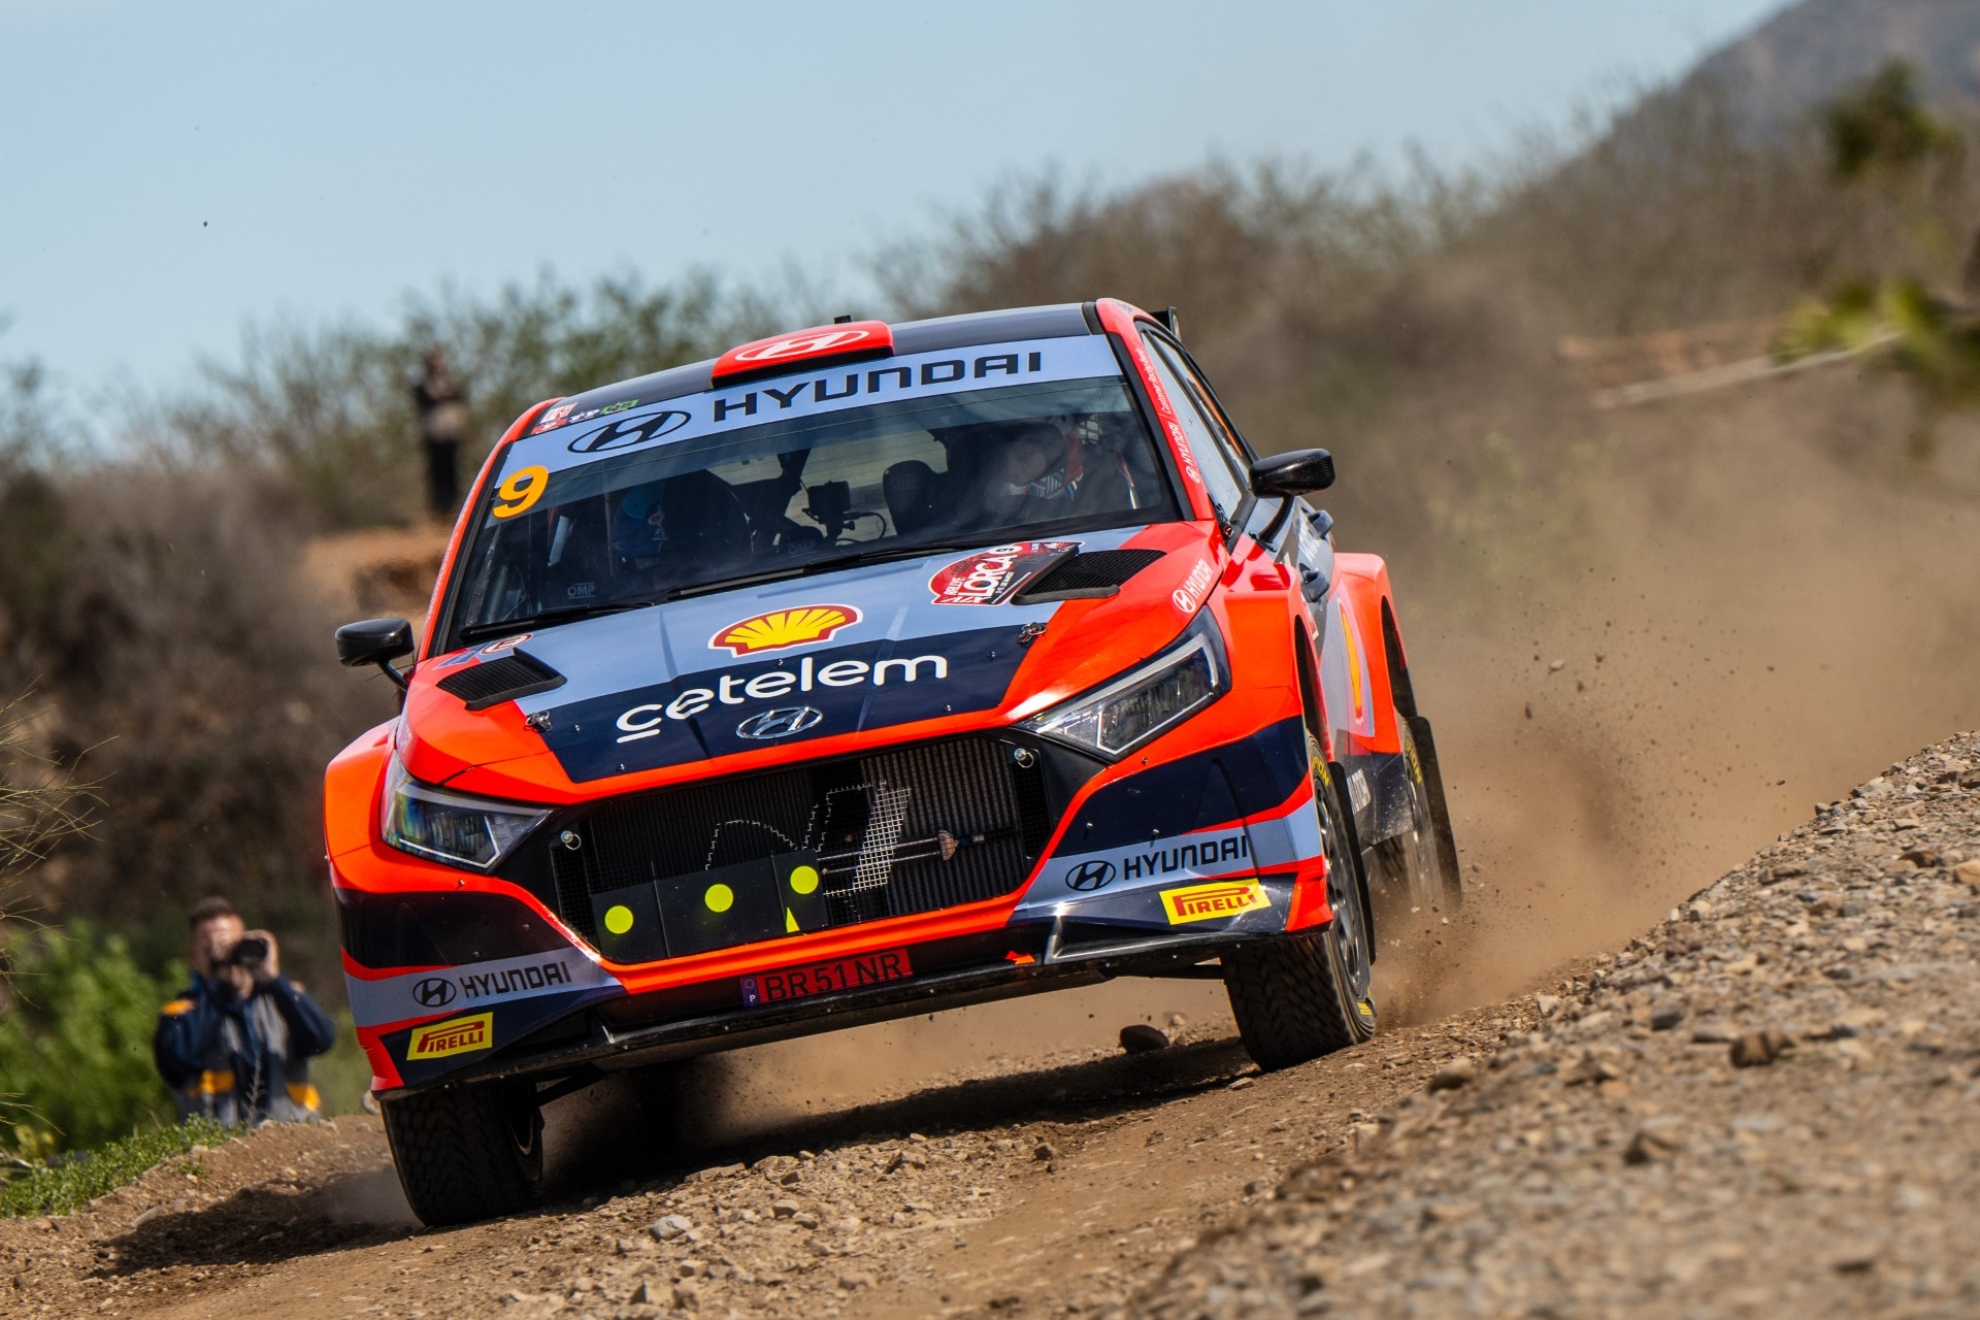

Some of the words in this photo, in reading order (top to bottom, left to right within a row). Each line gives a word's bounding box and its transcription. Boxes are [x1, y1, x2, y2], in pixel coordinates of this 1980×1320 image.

[714, 352, 1041, 422] HYUNDAI
[493, 465, 550, 519] 9
[567, 584, 595, 598] OMP
[957, 554, 1018, 597] LORCA
[616, 655, 947, 743] cetelem
[1124, 835, 1249, 880] HYUNDAI
[1172, 886, 1258, 917] PIRELLI
[459, 961, 572, 998] HYUNDAI
[749, 994, 756, 1003] P
[417, 1020, 485, 1054] PIRELLI
